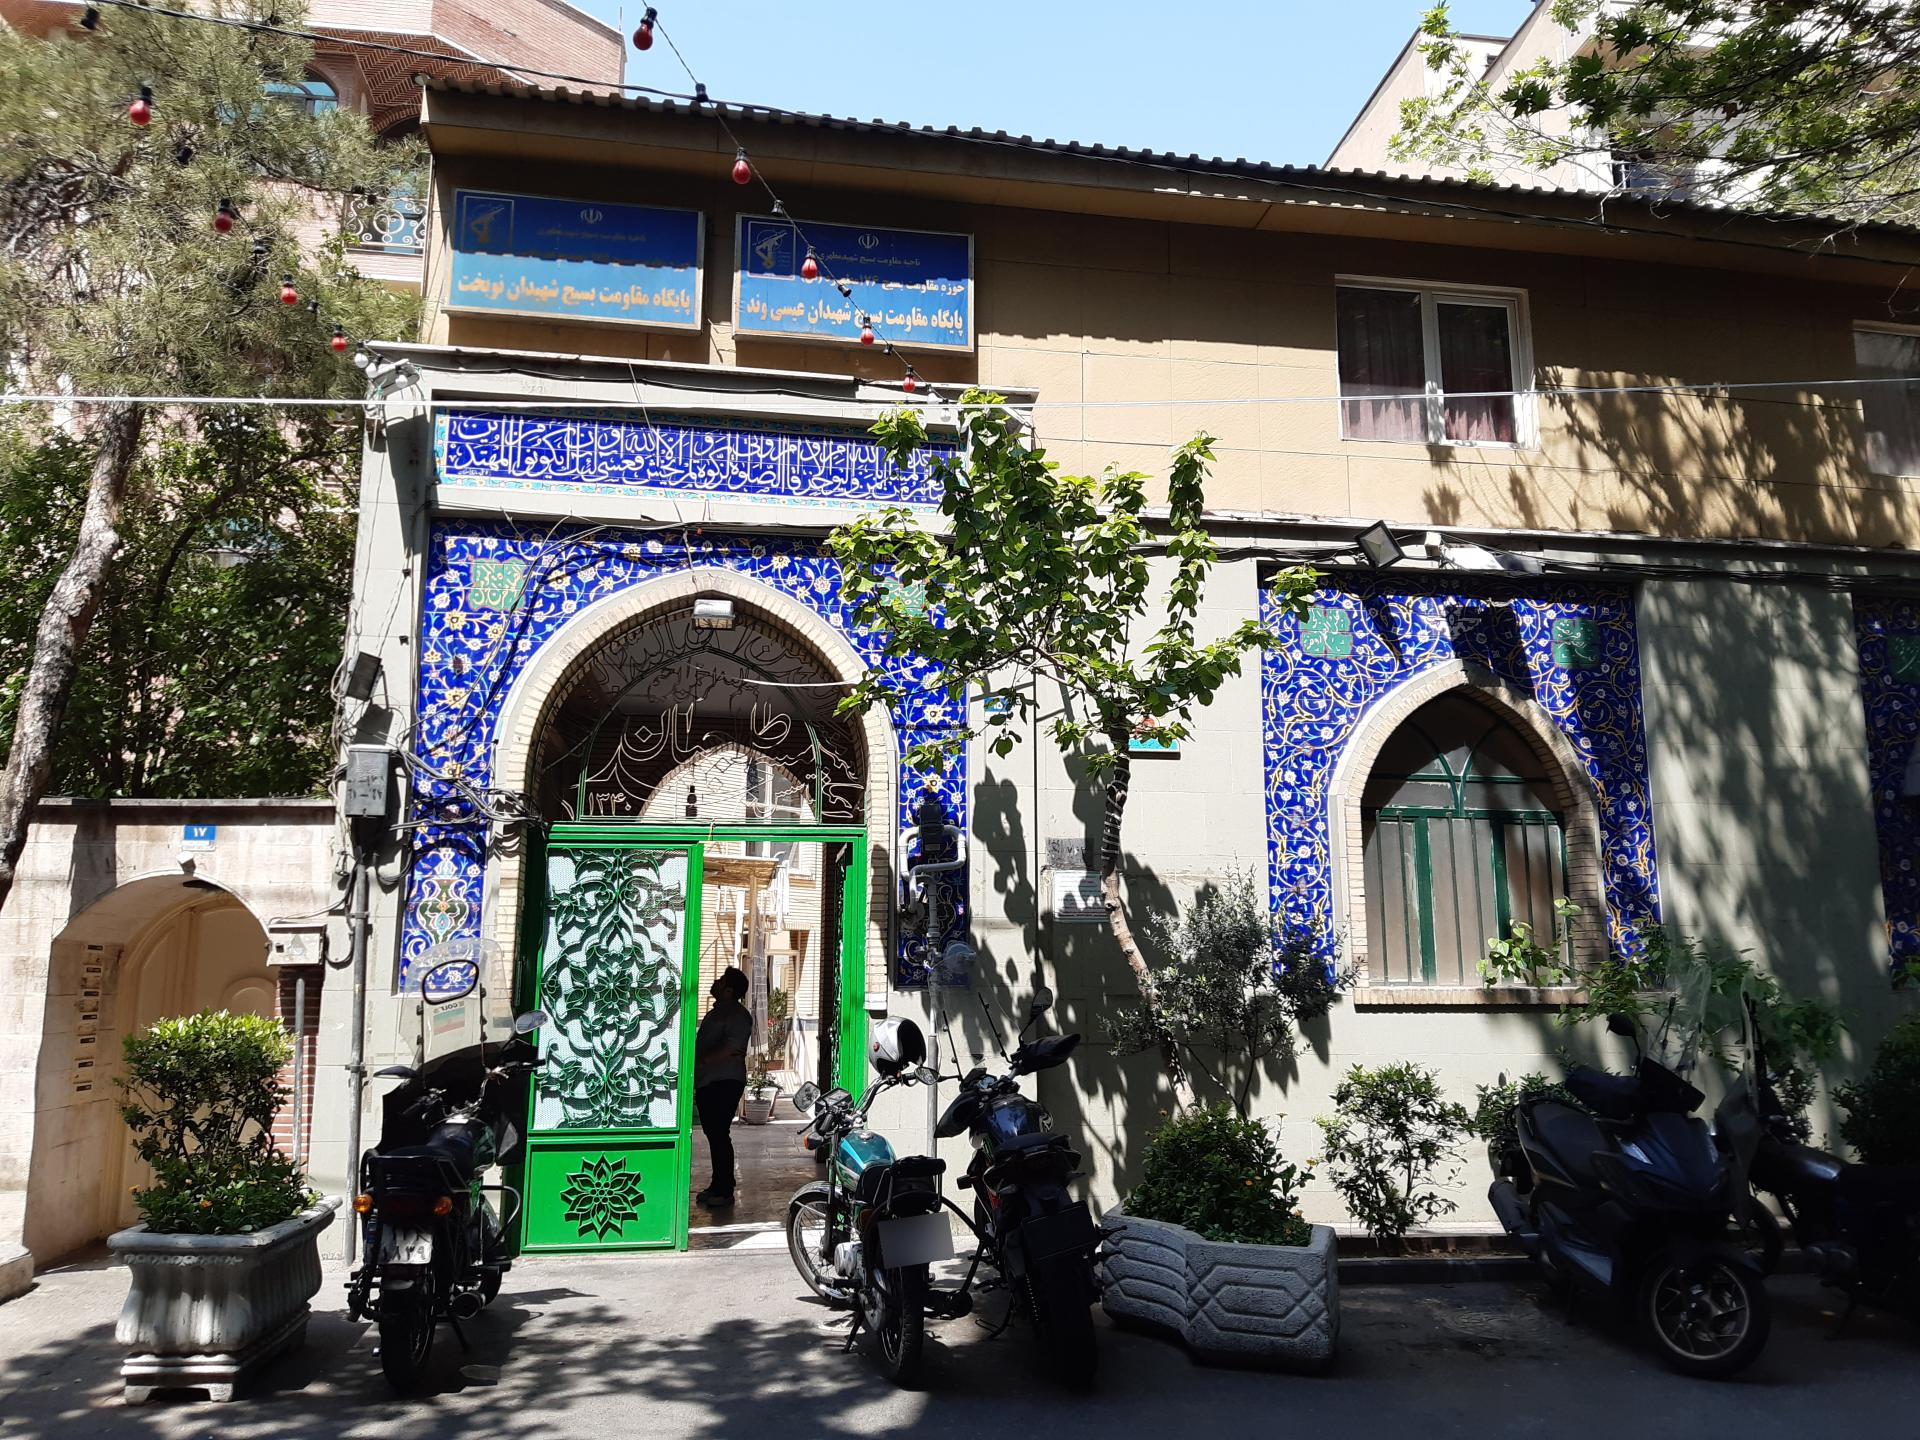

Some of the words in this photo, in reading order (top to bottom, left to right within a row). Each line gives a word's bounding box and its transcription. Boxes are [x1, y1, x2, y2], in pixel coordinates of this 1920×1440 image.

[507, 275, 559, 303] شهیدان
[562, 284, 596, 307] بسیج
[599, 284, 649, 311] مقاومت
[653, 287, 690, 316] پایگاه
[746, 293, 768, 321] وند
[770, 302, 806, 321] عیسی
[807, 298, 852, 325] شهیدان
[853, 308, 883, 329] بسیج
[886, 305, 929, 333] مقاومت
[931, 306, 964, 338] پایگاه
[193, 827, 208, 837] ۱۷
